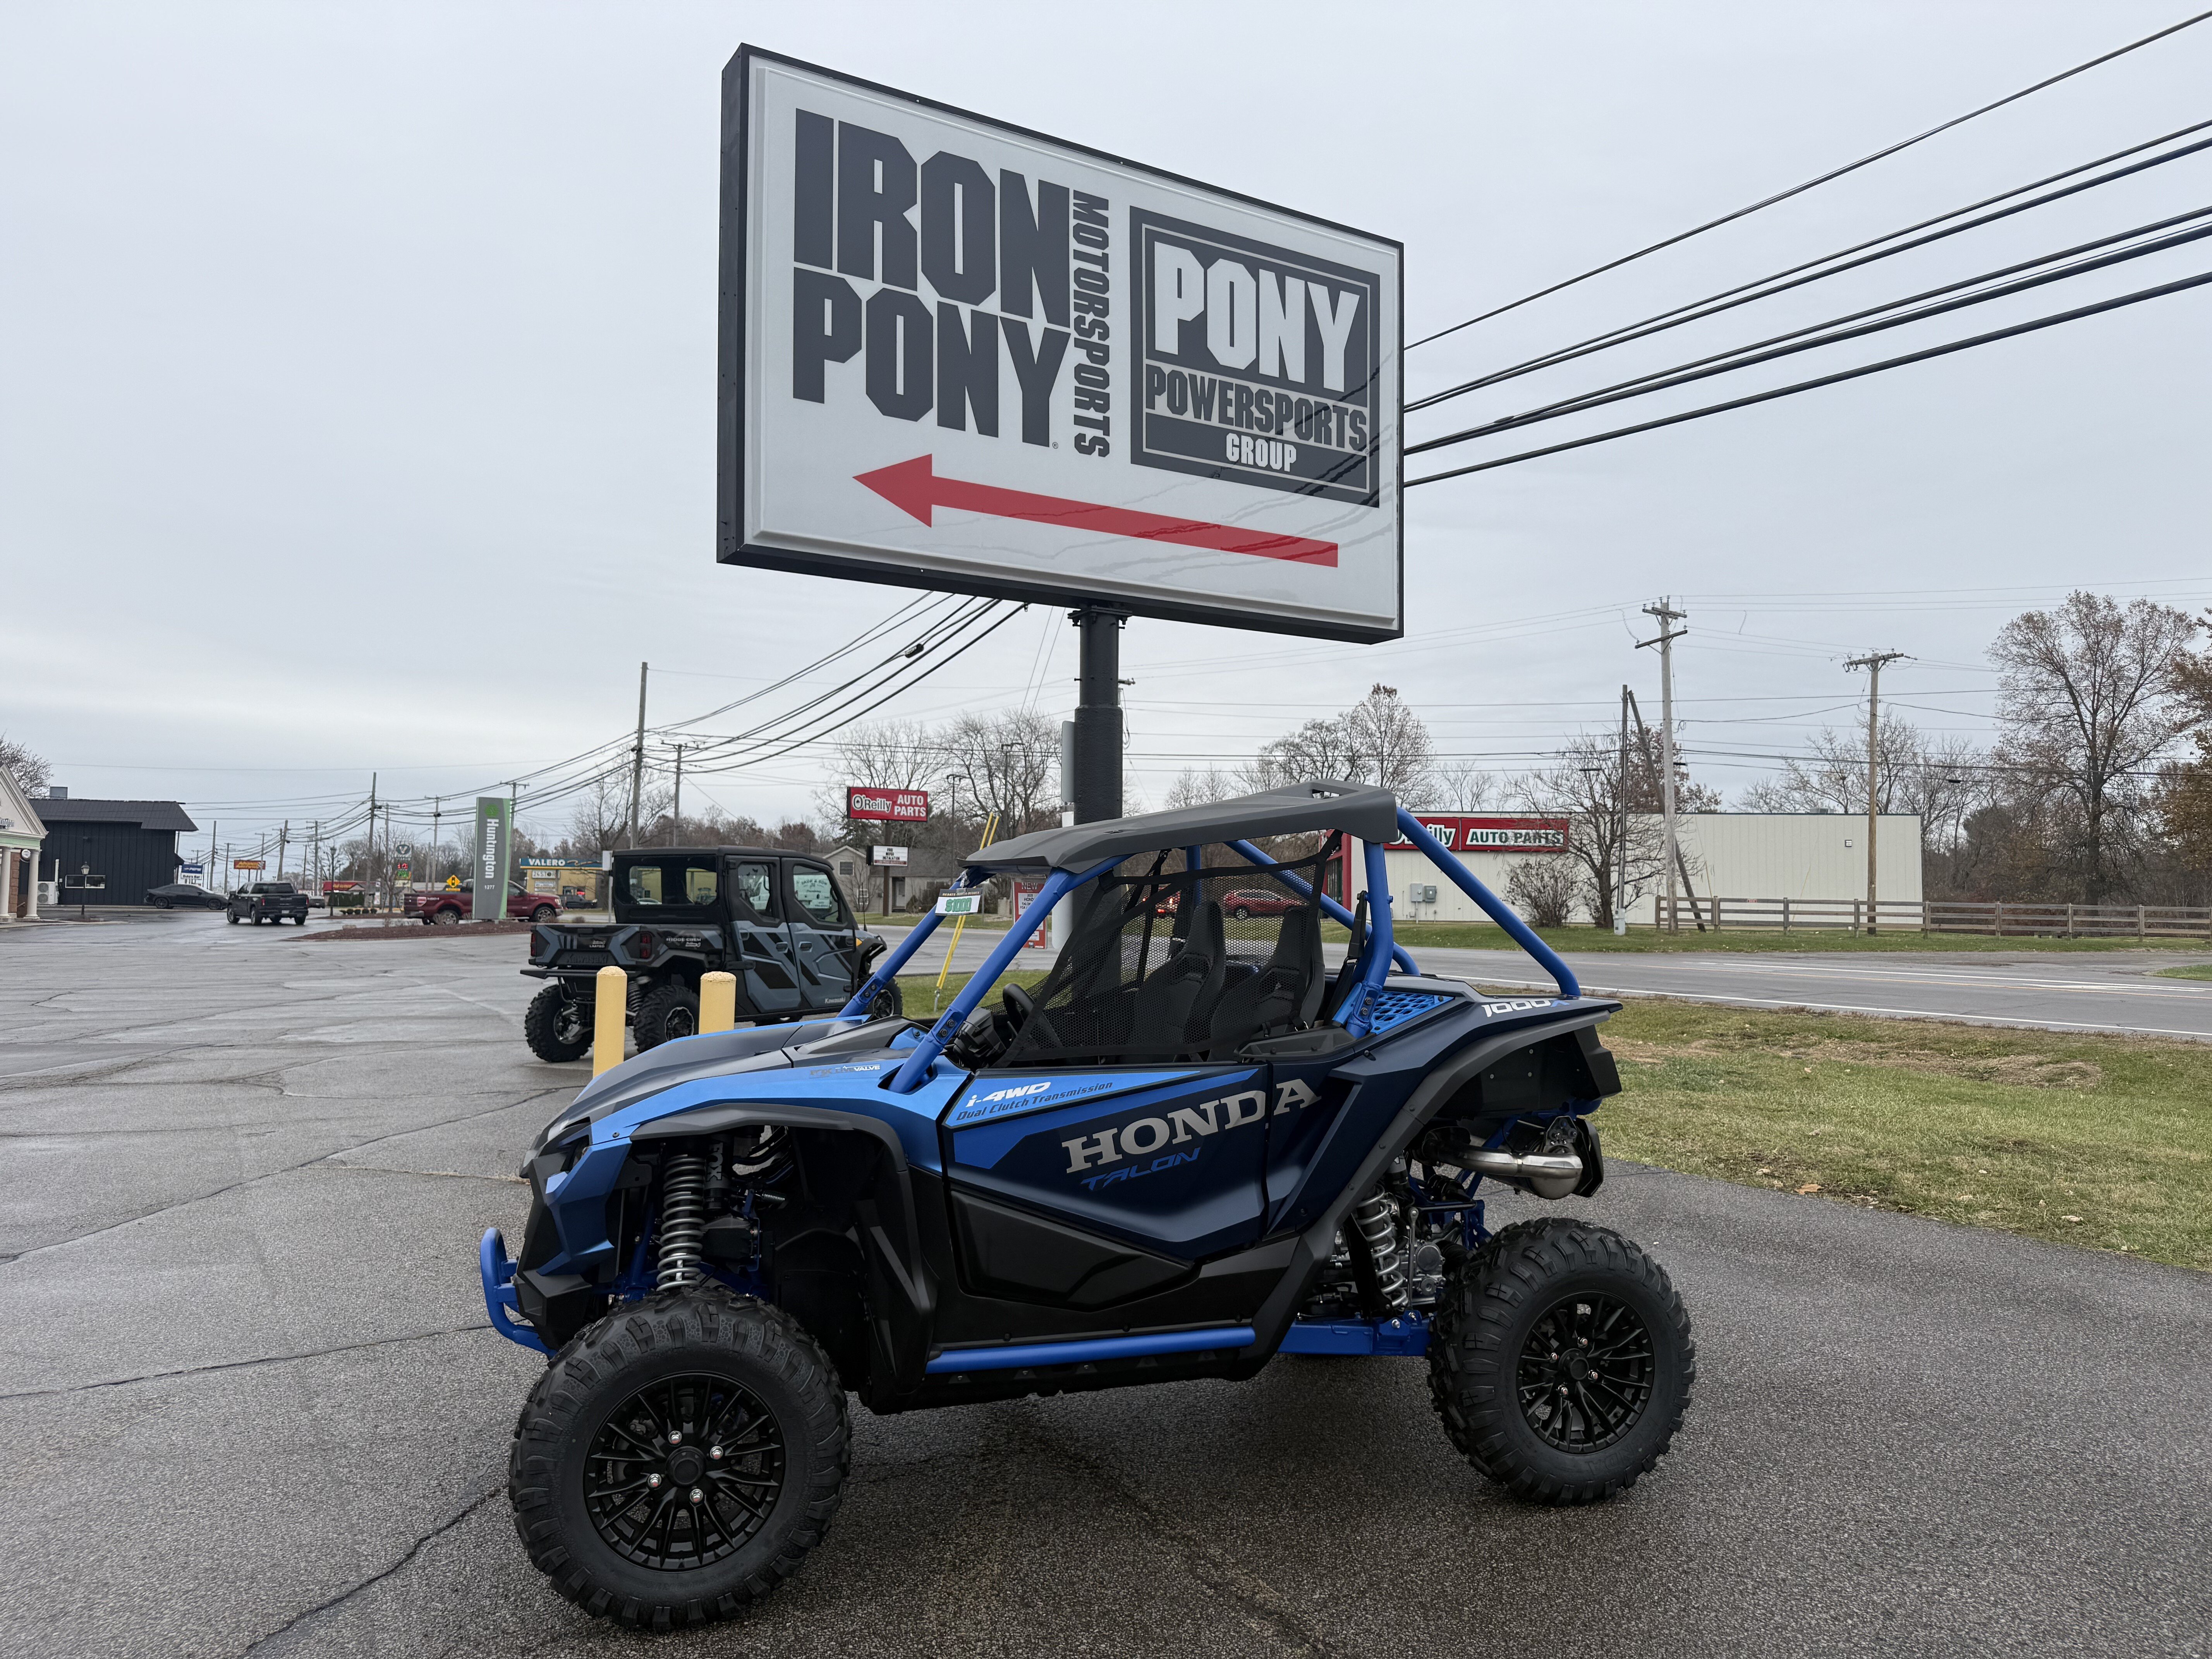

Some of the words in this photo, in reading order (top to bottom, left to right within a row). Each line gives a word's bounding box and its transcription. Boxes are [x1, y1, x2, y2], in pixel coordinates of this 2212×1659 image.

[794, 108, 1070, 328] IRON
[1073, 190, 1109, 457] MOTORSPORTS
[1155, 241, 1360, 392] PONY
[793, 267, 1071, 447] PONY
[1146, 364, 1367, 451] POWERSPORTS
[1226, 433, 1296, 472] GROUP
[853, 795, 891, 812] O'Reilly
[895, 806, 926, 816] PARTS
[898, 795, 924, 805] AUTO
[483, 819, 499, 878] Huntington
[1470, 831, 1508, 843] AUTO
[1514, 831, 1561, 843] PARTS
[945, 898, 972, 912] $1000
[956, 1107, 986, 1121] Dual
[989, 1098, 1029, 1114] Clutch
[1032, 1082, 1113, 1104] Transmission
[965, 1082, 1051, 1108] i-4WD
[1061, 1079, 1321, 1173] HONDA
[1081, 1147, 1200, 1192] TALON
